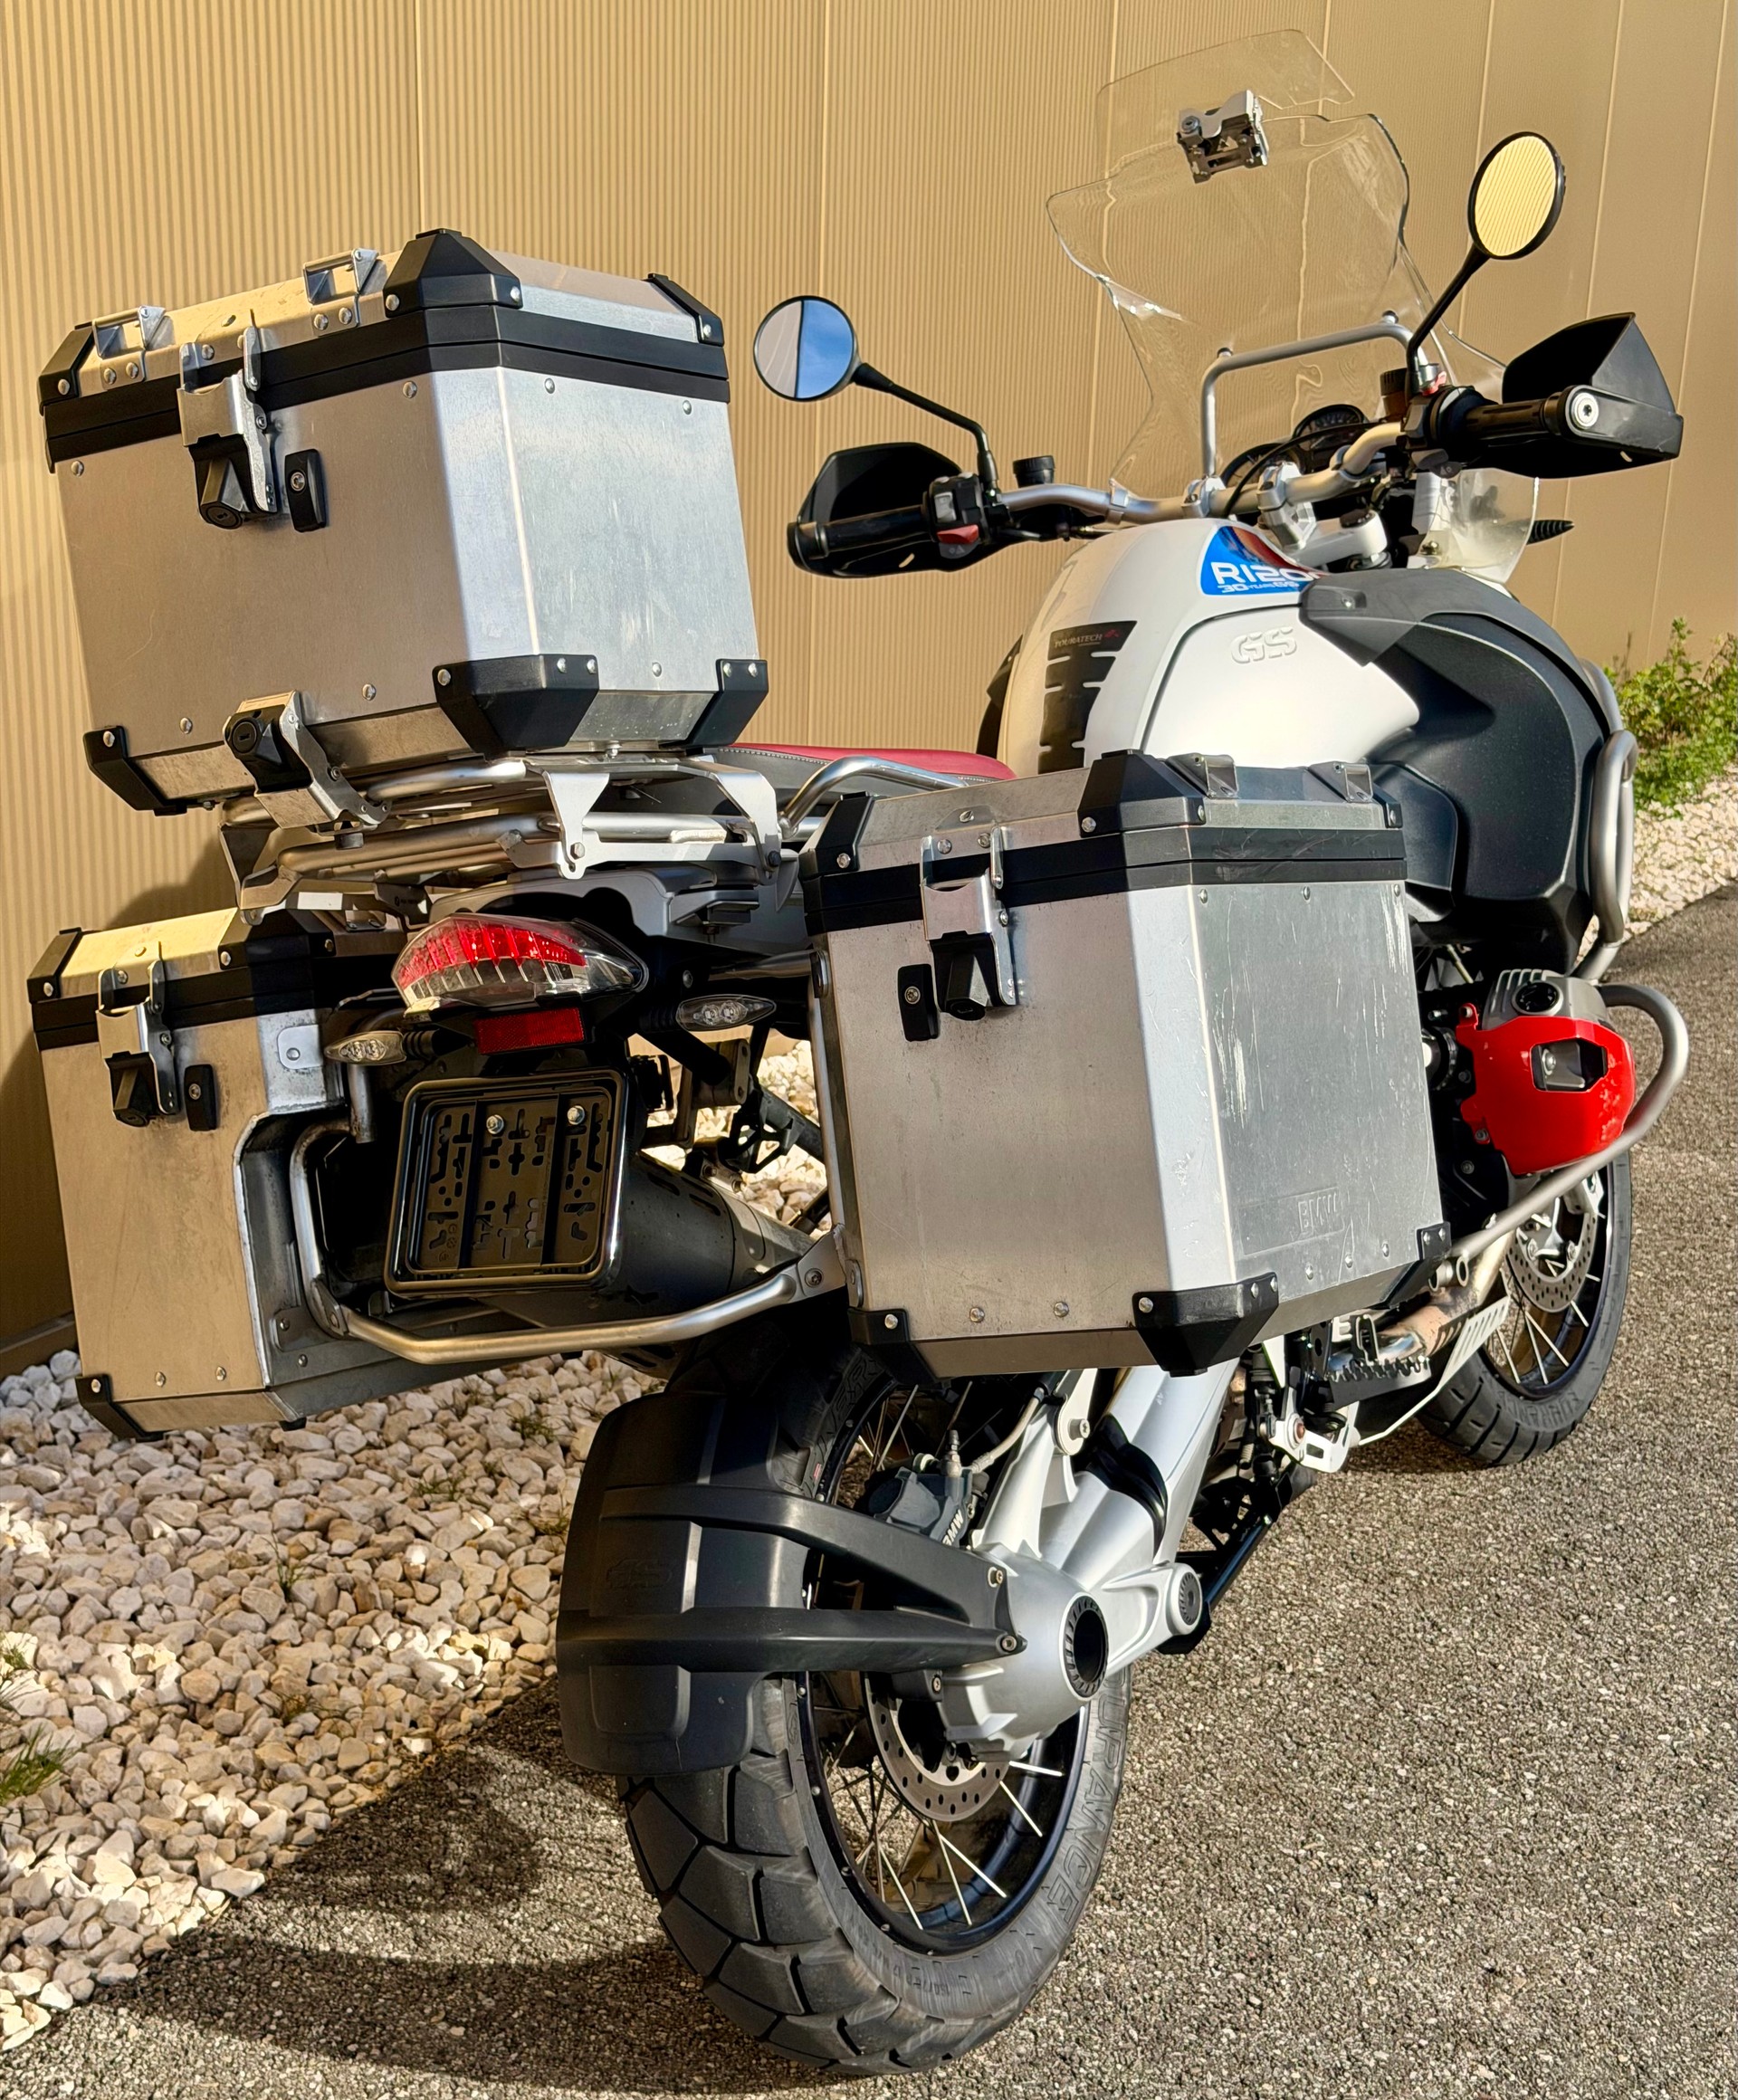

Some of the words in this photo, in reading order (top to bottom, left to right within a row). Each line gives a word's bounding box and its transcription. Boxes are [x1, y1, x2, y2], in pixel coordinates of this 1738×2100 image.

[1218, 583, 1249, 593] 30
[1054, 634, 1103, 648] TOURATECH
[1231, 626, 1297, 664] GS
[1298, 1192, 1337, 1233] BMW
[1047, 1666, 1126, 1924] OURANCE
